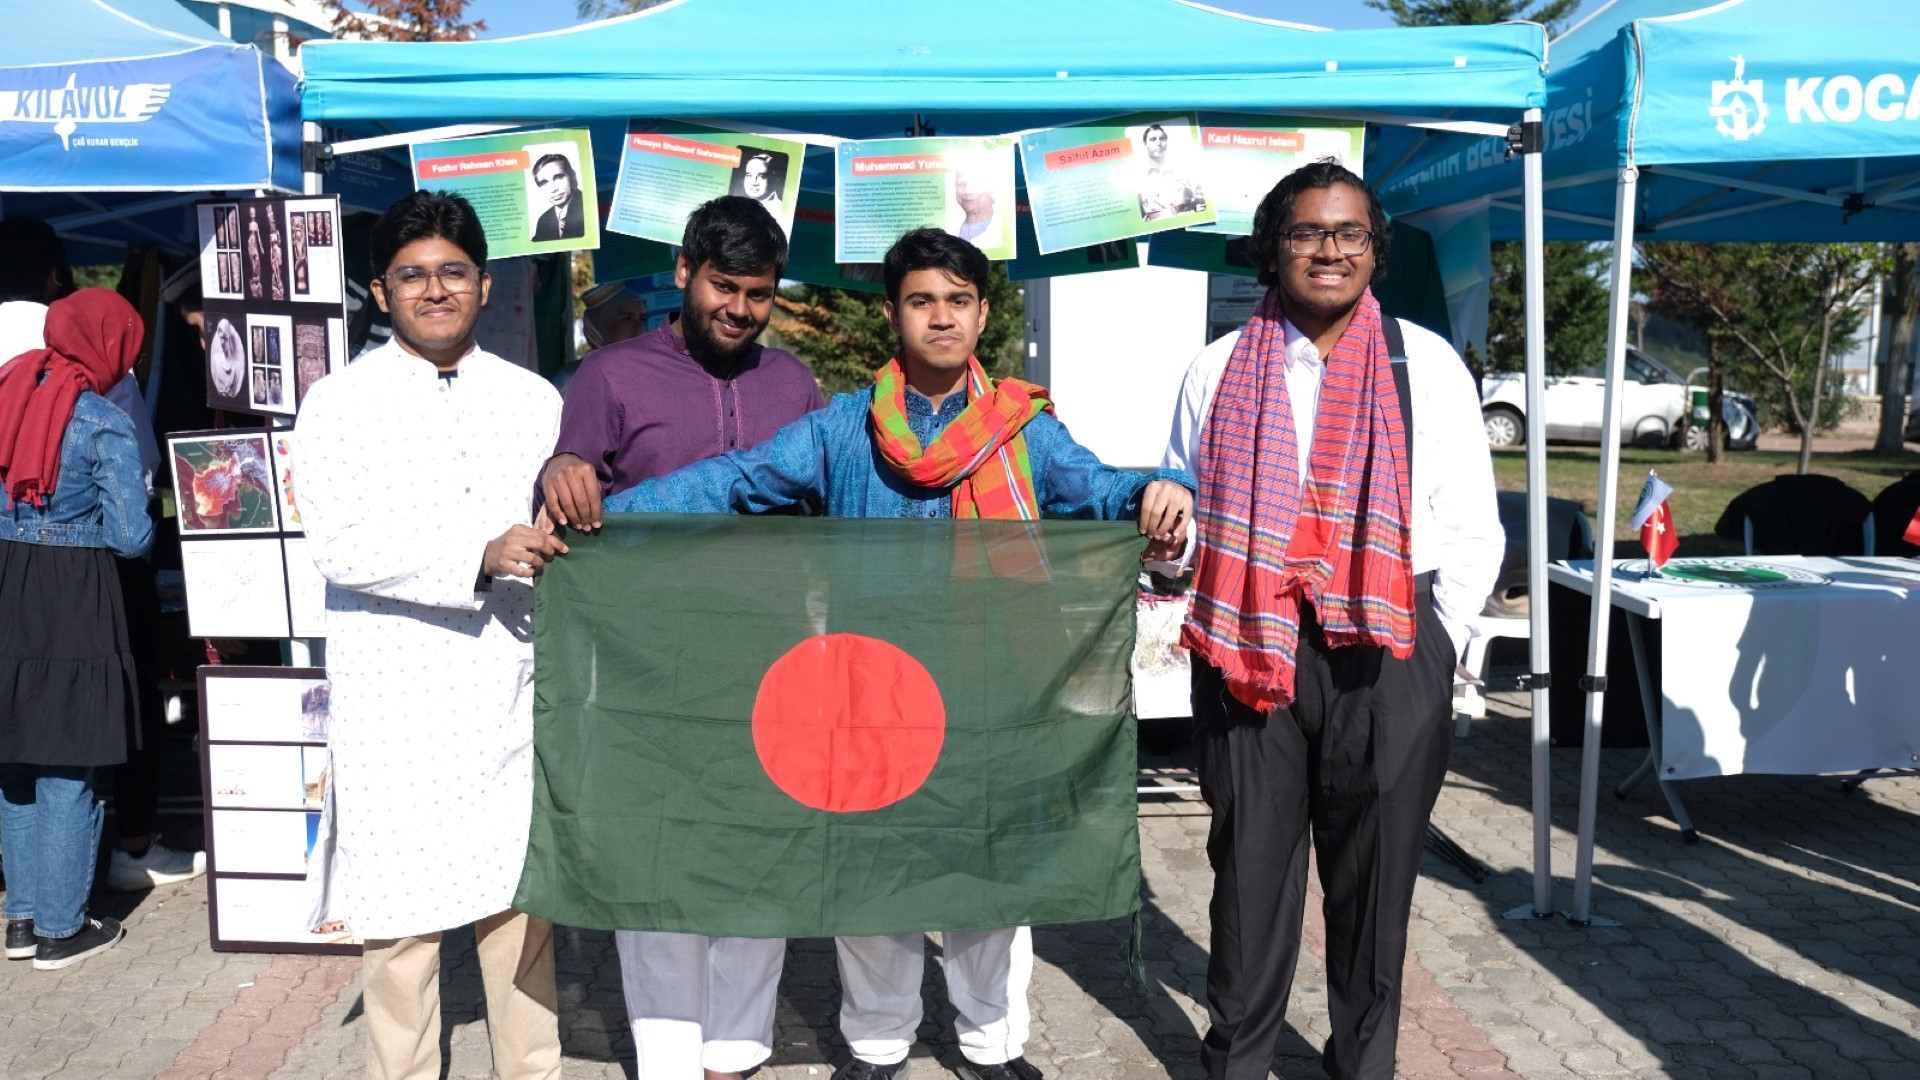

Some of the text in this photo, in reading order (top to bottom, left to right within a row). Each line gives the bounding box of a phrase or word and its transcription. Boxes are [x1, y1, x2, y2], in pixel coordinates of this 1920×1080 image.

[109, 137, 139, 148] GENÇLİK
[1207, 133, 1297, 147] Kazi Nazrul Islam
[1059, 147, 1120, 165] Saiful Azam
[432, 158, 518, 173] Fazlur Rahman Khan
[855, 159, 946, 172] Muhammad Yunu
